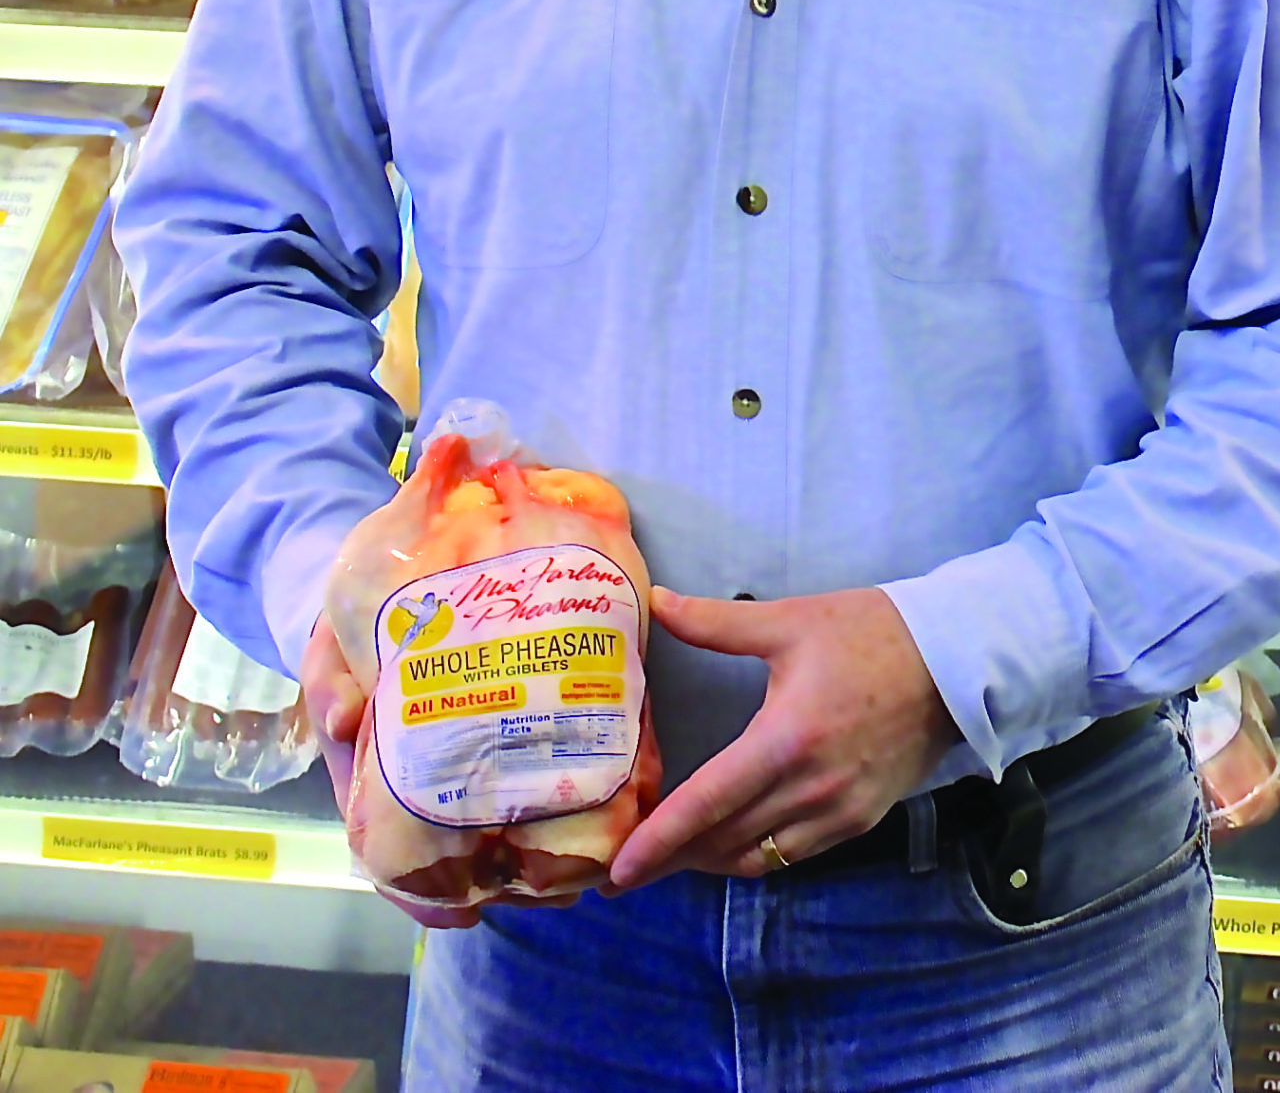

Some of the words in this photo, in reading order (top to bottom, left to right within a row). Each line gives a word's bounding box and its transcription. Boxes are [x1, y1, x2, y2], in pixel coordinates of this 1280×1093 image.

[463, 592, 634, 632] Pheasants
[408, 646, 491, 682] WHOLE
[500, 632, 617, 664] PHEASANT
[463, 668, 501, 683] WITH
[505, 659, 569, 677] GIBLETS
[408, 699, 433, 716] All
[440, 685, 516, 710] Natural
[500, 713, 551, 726] Nutrition
[501, 725, 532, 735] Facts
[438, 792, 453, 804] NET
[52, 835, 133, 852] MacFarlane's
[136, 842, 192, 856] Pheasant
[195, 846, 228, 859] Brats
[234, 849, 269, 862] $8.99
[1213, 917, 1266, 935] Whole
